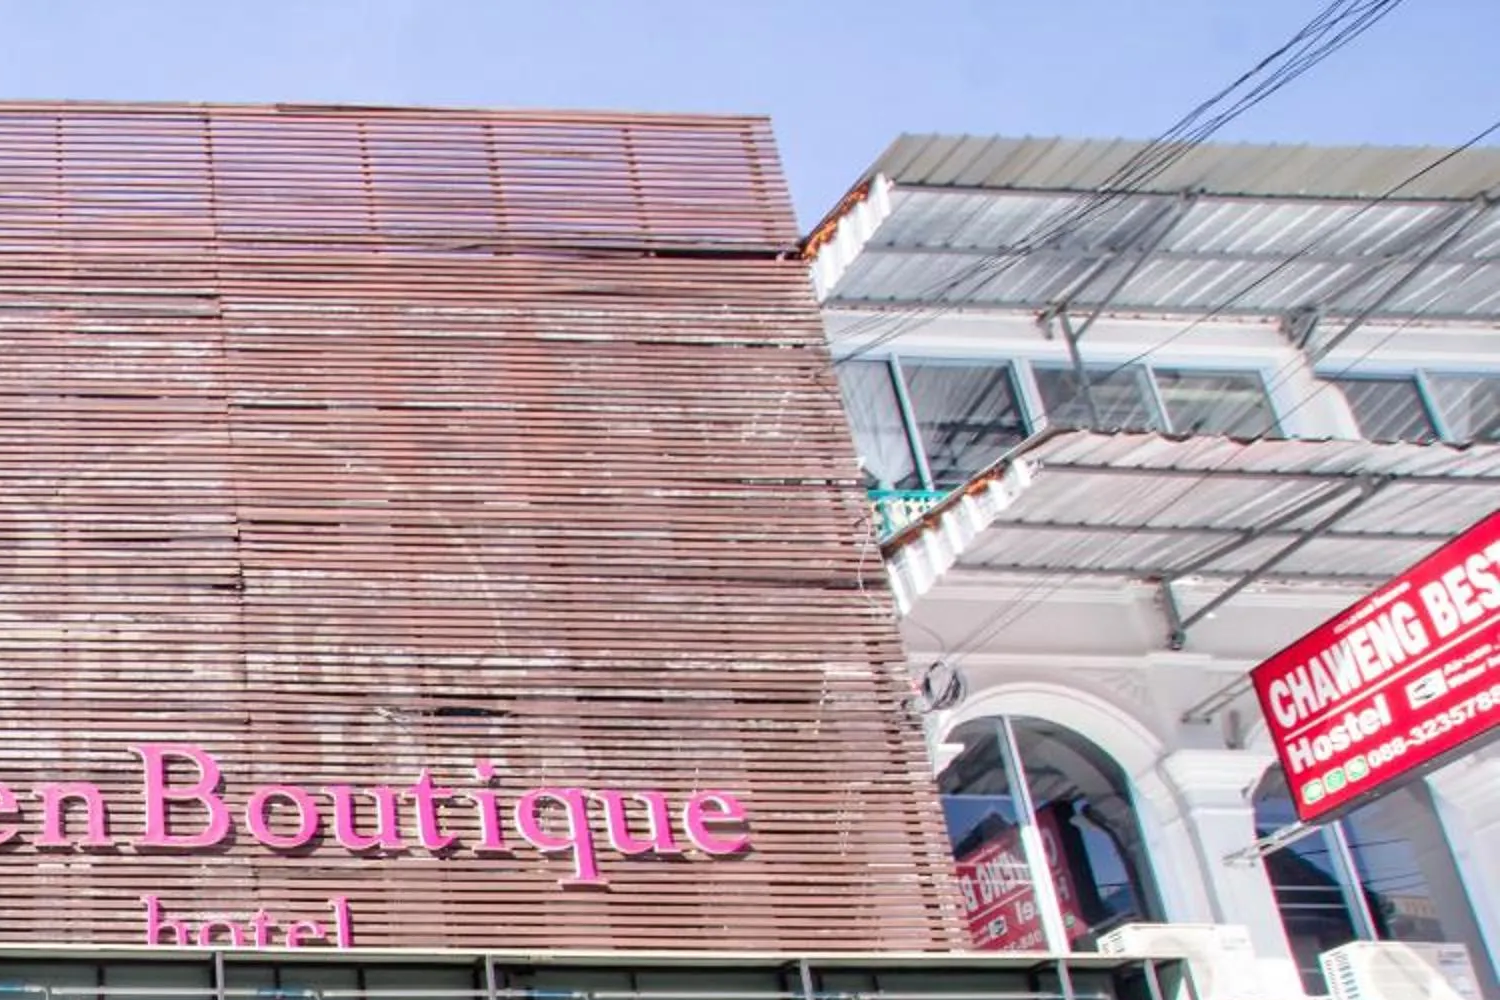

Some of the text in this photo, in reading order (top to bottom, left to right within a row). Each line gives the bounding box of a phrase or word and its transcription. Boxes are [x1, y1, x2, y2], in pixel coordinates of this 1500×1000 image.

[1269, 600, 1430, 729] CHAWENG
[1286, 693, 1392, 774] Hostel
[127, 741, 752, 888] Boutique
